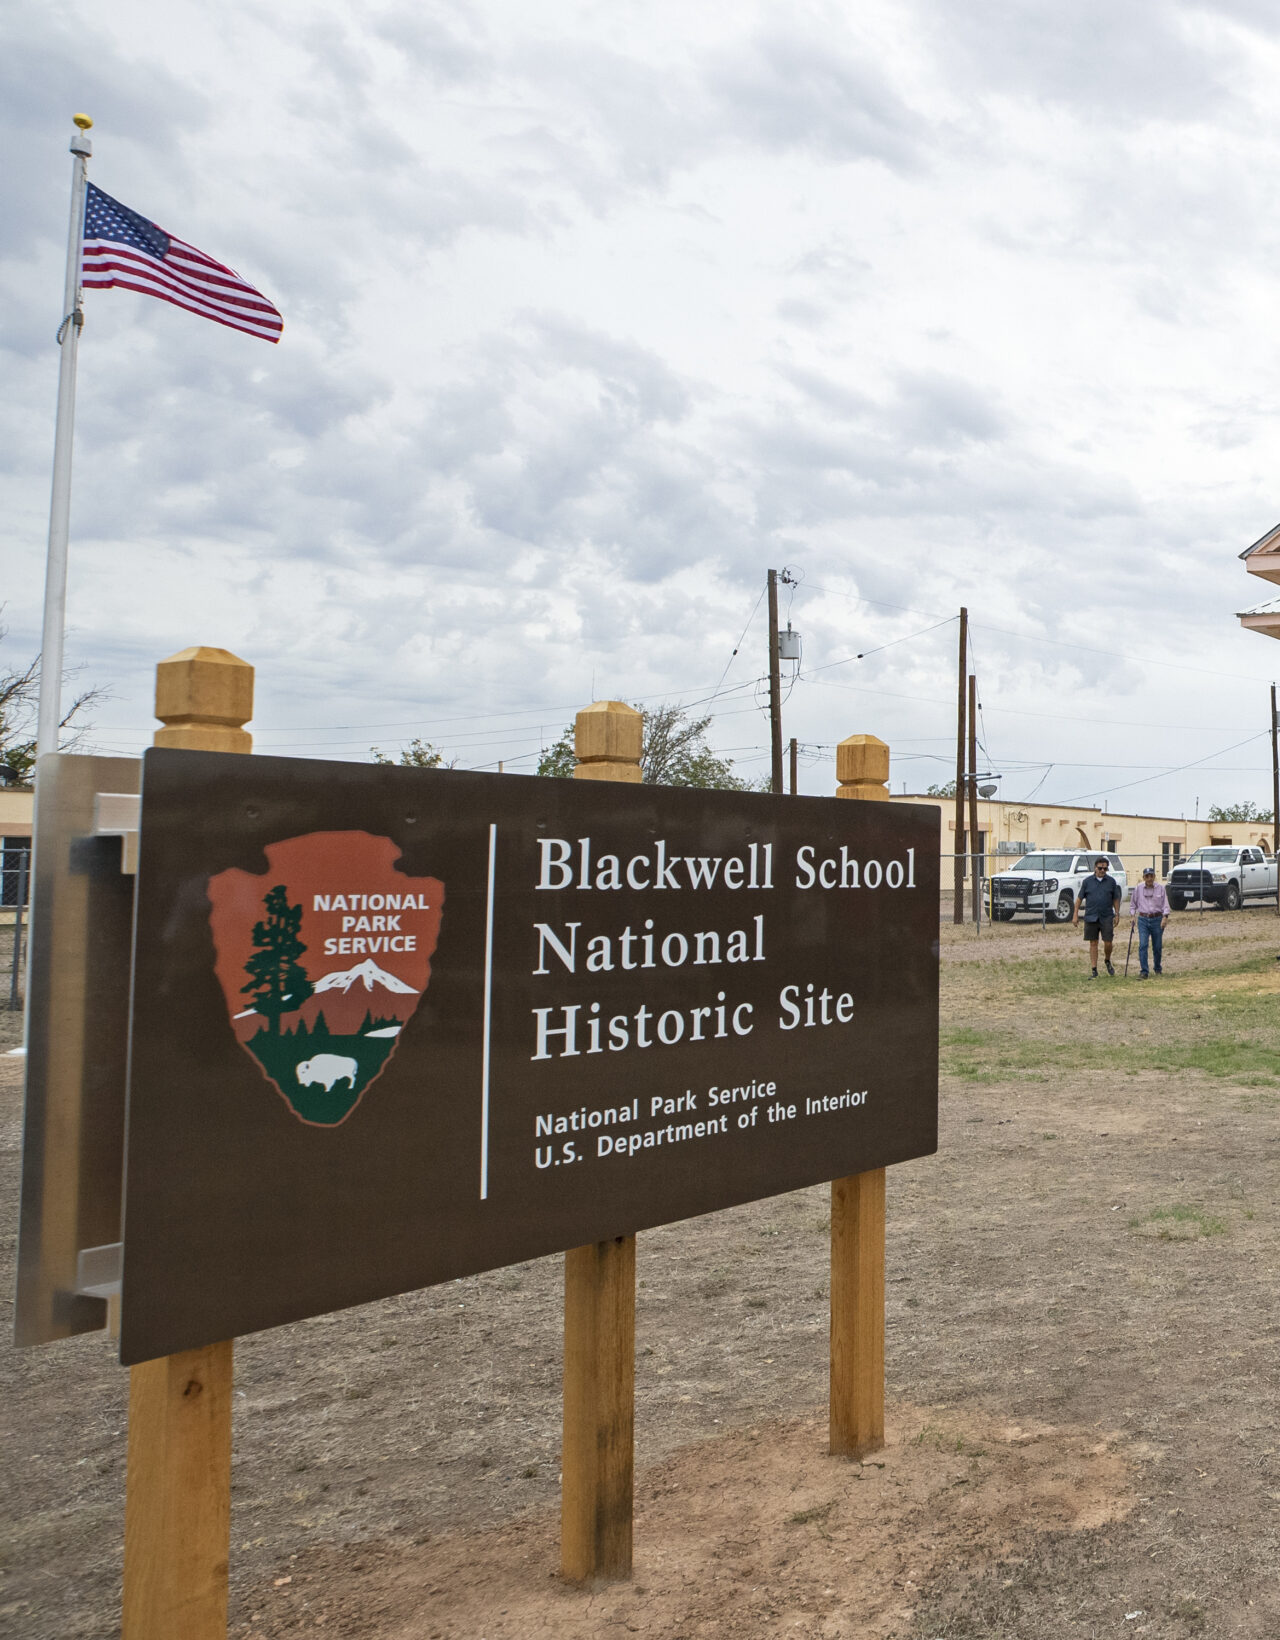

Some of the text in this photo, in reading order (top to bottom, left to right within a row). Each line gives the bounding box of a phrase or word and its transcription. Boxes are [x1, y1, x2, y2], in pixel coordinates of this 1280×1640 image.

[534, 837, 916, 891] Blackwell School
[313, 893, 430, 912] NATIONAL
[342, 914, 402, 933] PARK
[324, 935, 417, 956] SERVICE
[532, 914, 766, 975] National
[530, 983, 854, 1061] Historic Site
[535, 1079, 777, 1138] National Park Service
[535, 1089, 868, 1169] U.S. Department of the Interior
